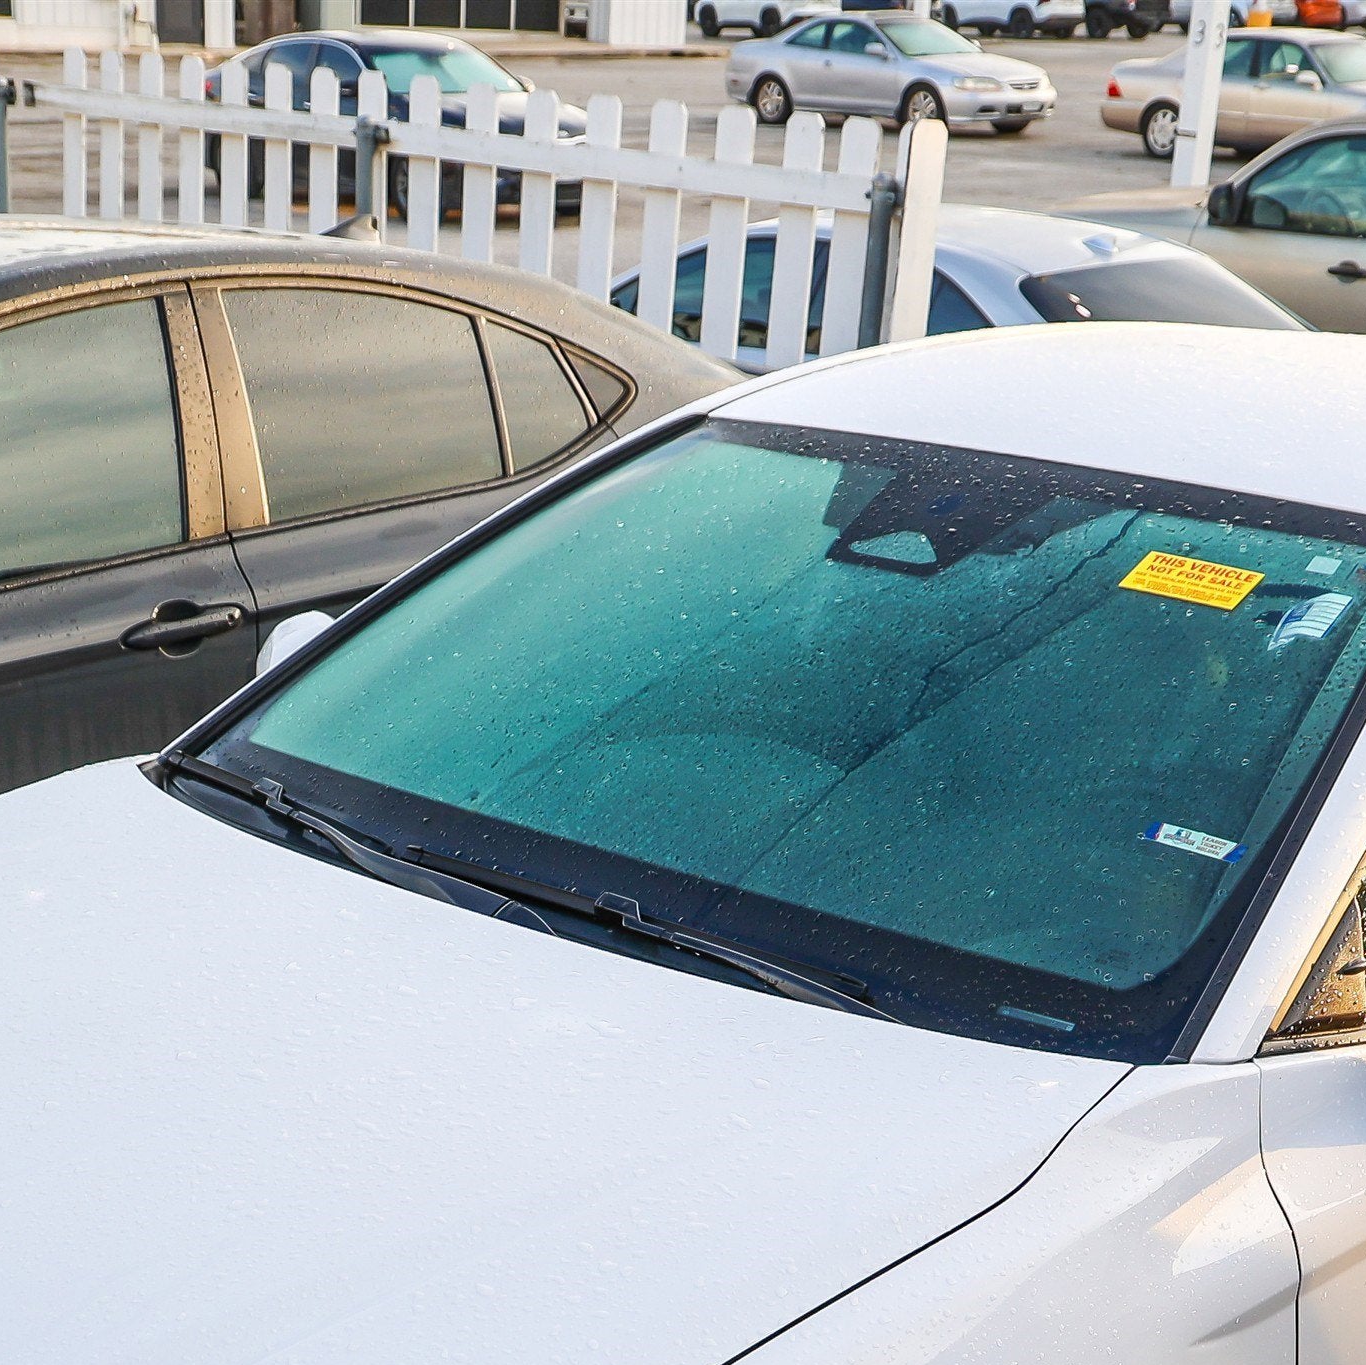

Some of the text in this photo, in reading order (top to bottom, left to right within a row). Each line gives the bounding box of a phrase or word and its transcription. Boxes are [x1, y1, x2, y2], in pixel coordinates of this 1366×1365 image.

[1146, 565, 1174, 575] NOT
[1176, 570, 1207, 582] FOR
[1208, 577, 1246, 590] SALE
[1152, 555, 1258, 583] THIS VEHICLE
